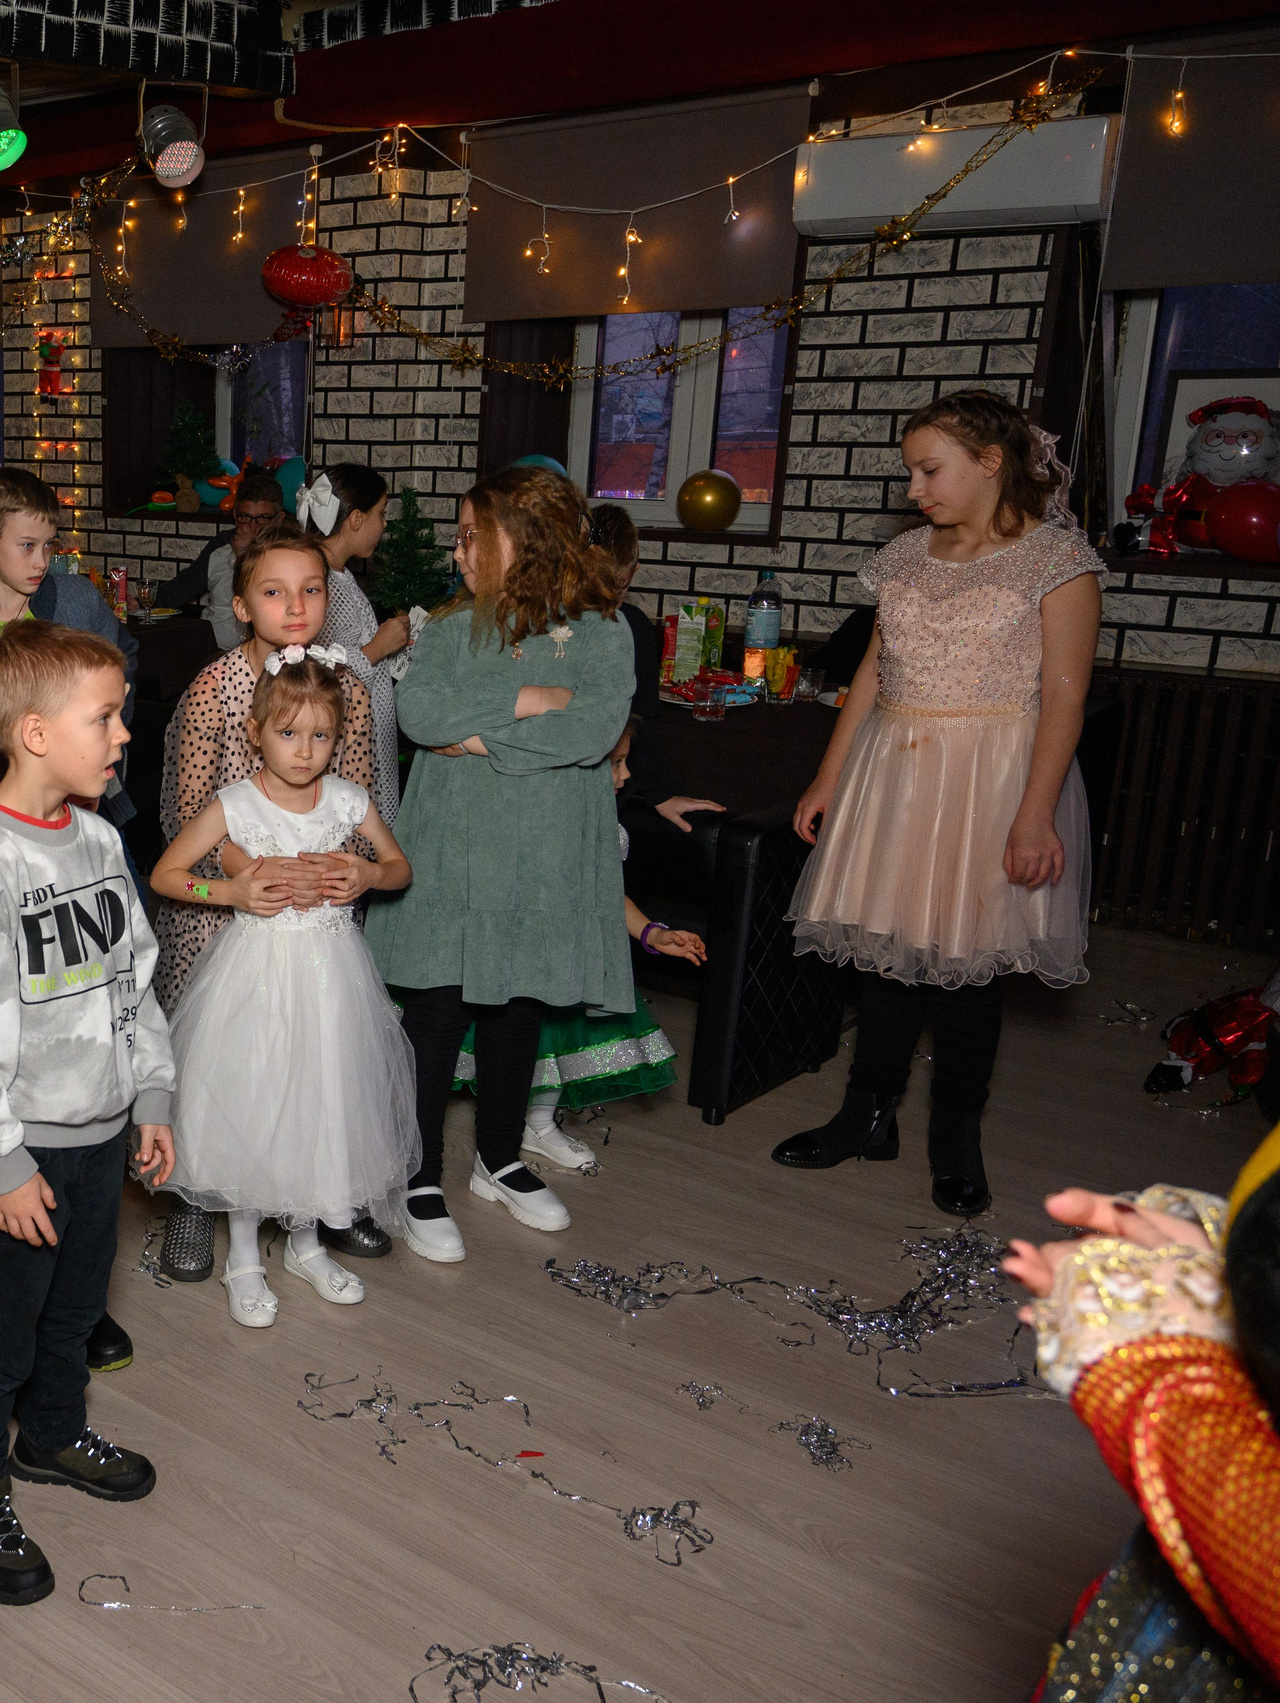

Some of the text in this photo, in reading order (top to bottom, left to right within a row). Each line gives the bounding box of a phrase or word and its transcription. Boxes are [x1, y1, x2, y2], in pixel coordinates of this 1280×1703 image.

[21, 888, 126, 976] FIND
[28, 962, 103, 994] THE WIND
